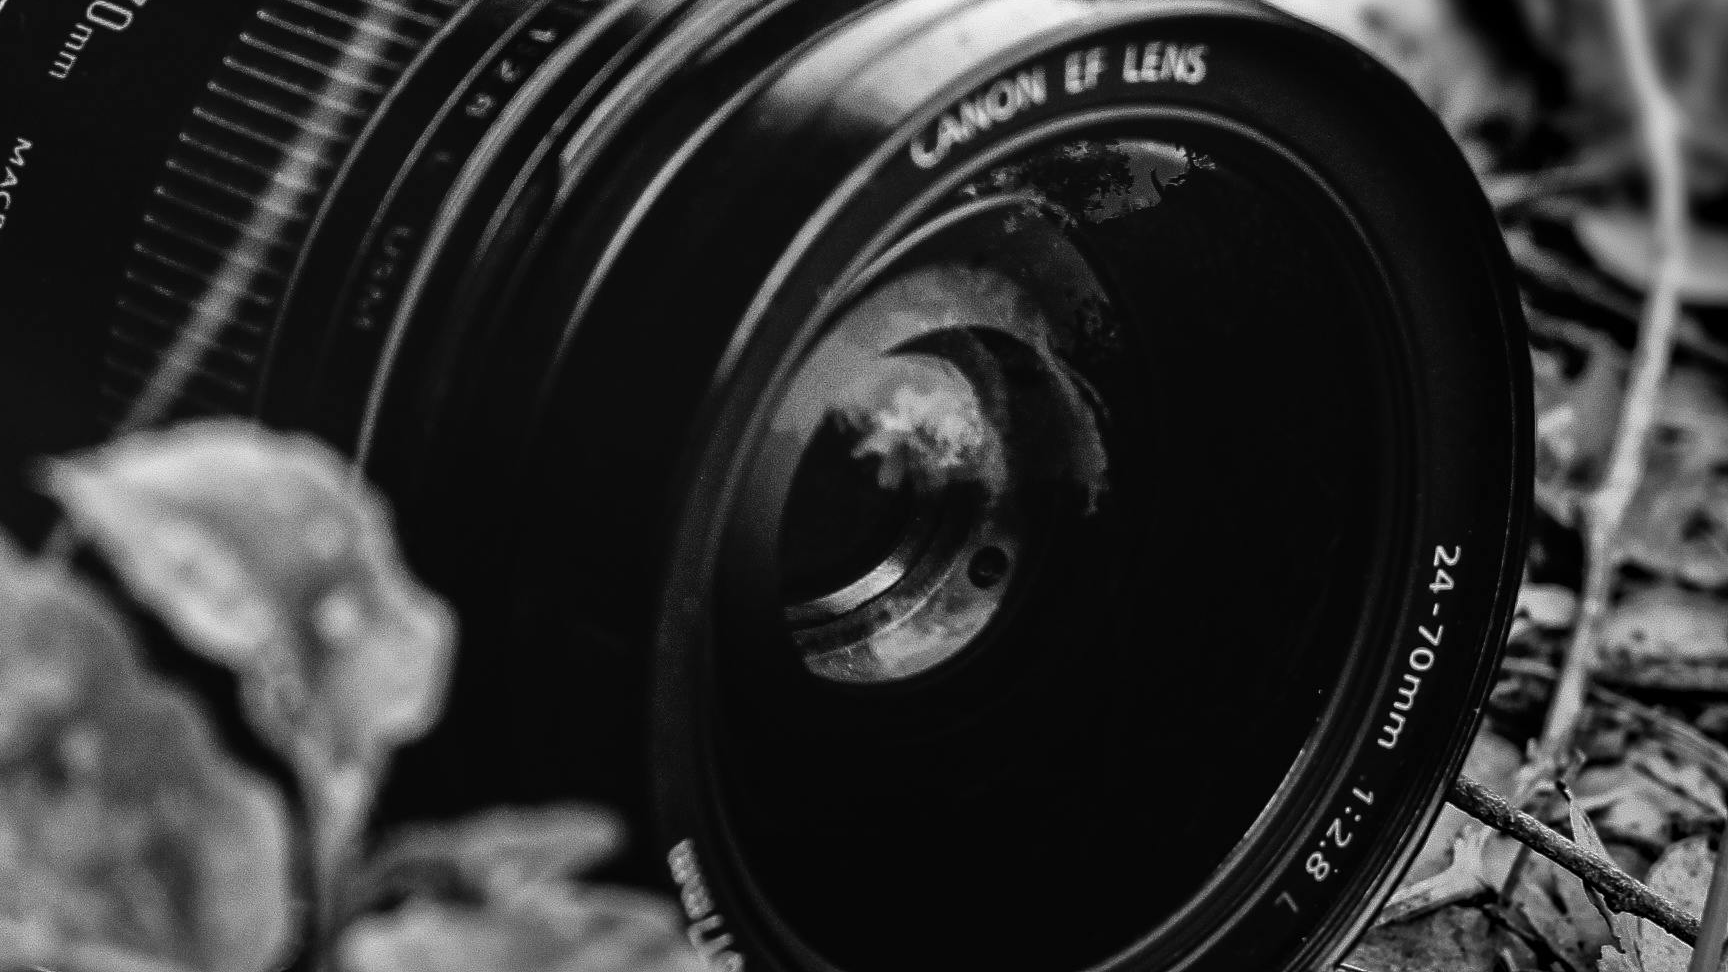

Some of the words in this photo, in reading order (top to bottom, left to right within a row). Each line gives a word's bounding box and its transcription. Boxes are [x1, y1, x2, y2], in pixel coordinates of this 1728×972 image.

[909, 68, 1048, 170] CANON
[1064, 47, 1108, 95] EF
[1122, 41, 1209, 86] LENS
[1377, 544, 1462, 750] 24-70mm
[1305, 786, 1375, 882] 1:2.8
